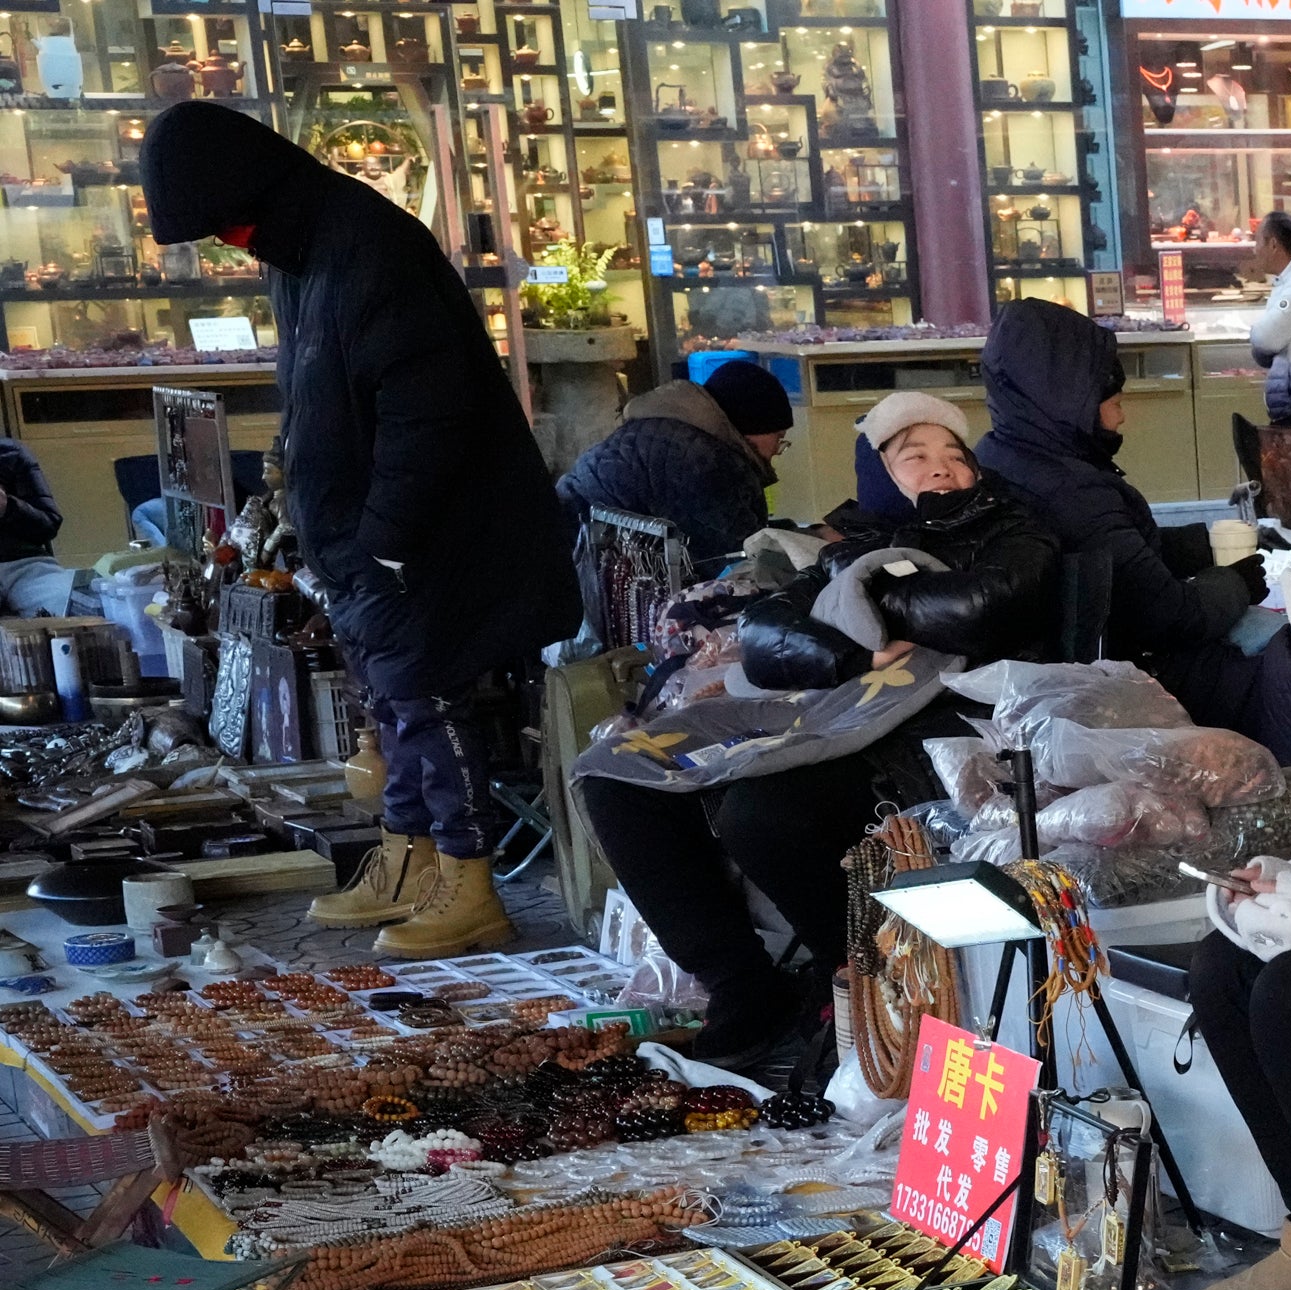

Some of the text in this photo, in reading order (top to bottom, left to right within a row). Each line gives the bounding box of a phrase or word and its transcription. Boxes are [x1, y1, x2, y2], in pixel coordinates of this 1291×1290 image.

[937, 1038, 1005, 1121] 唐卡
[912, 1108, 1012, 1186] 批发 零售
[936, 1163, 973, 1212] 代发
